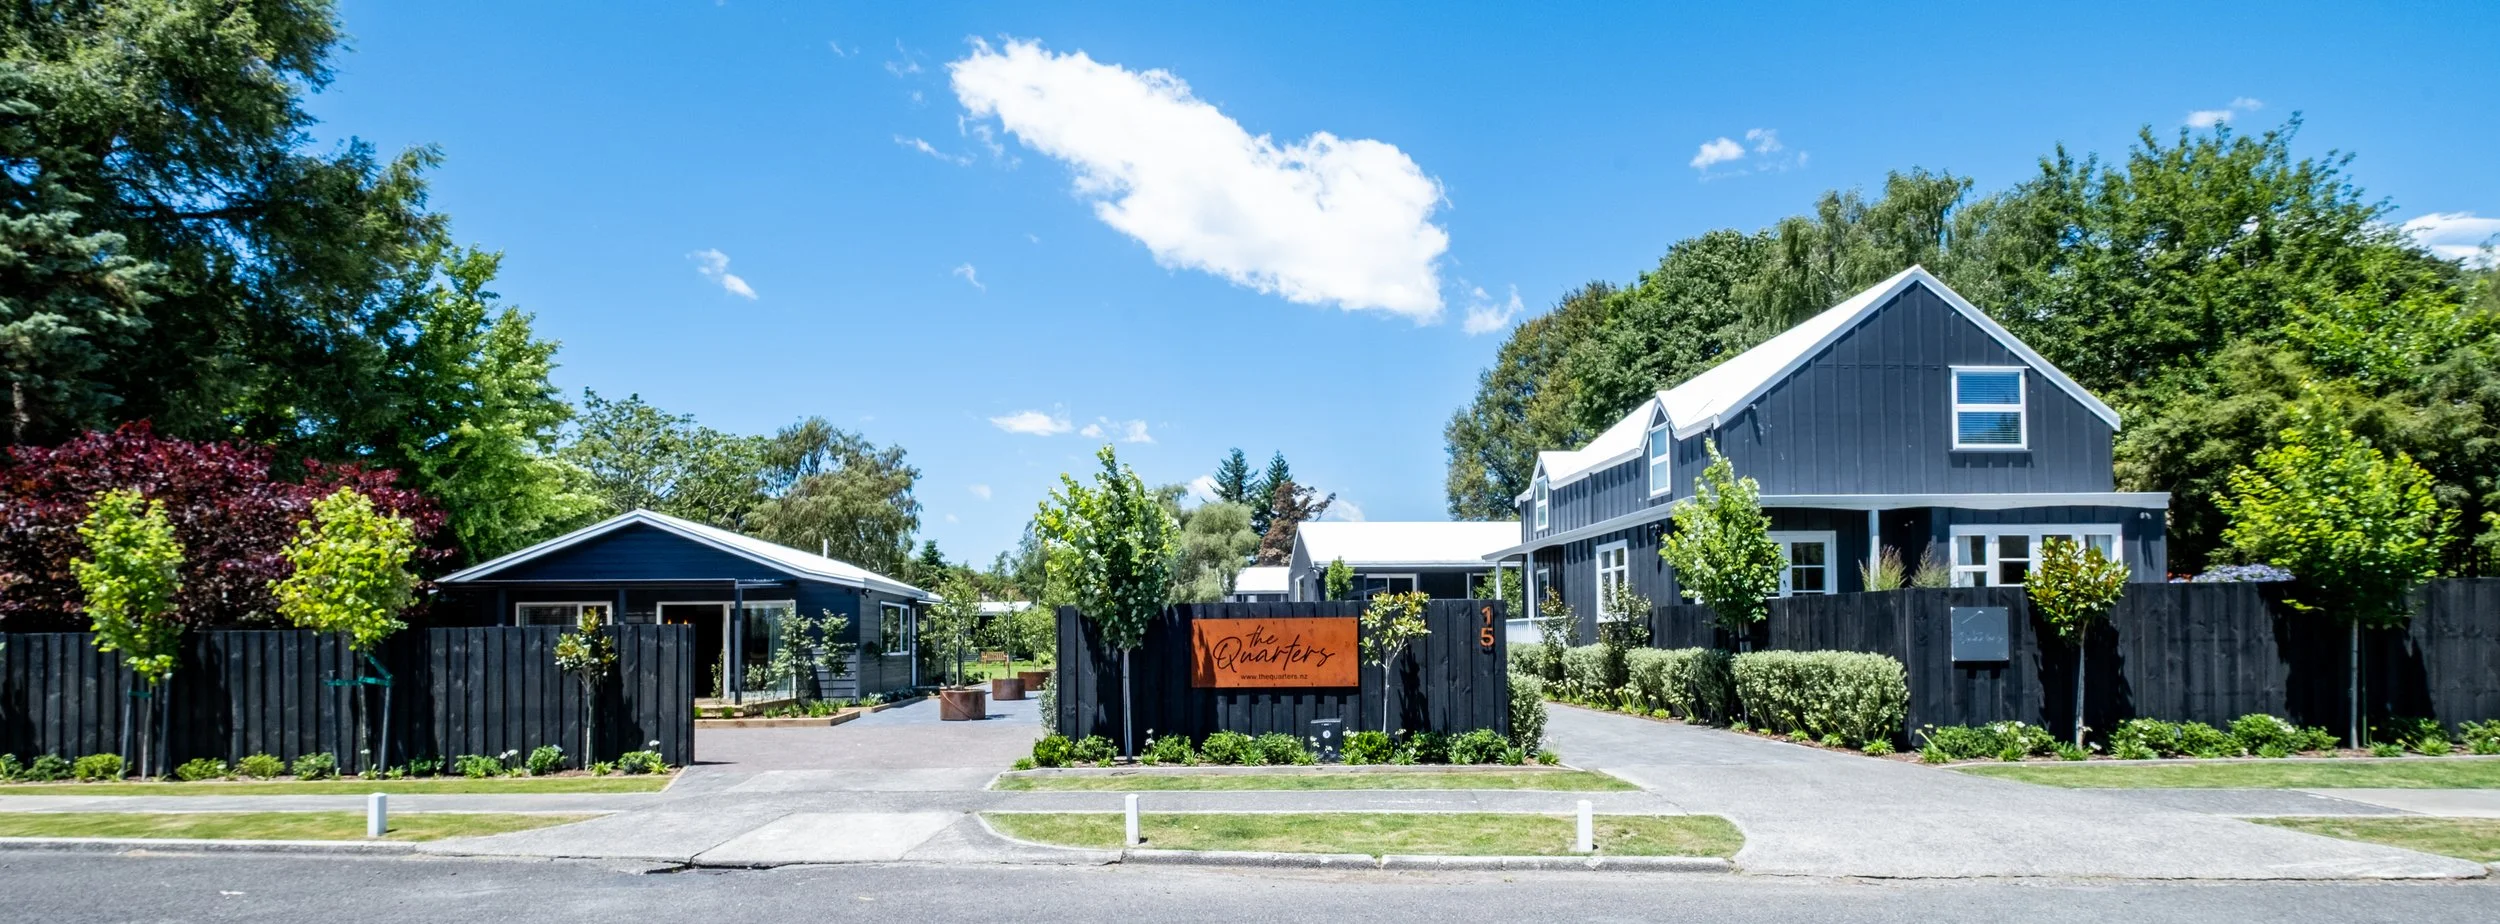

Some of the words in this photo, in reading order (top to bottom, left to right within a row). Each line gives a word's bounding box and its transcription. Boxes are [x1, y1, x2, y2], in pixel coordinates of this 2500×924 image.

[1246, 624, 1279, 648] the
[1480, 606, 1494, 647] 15
[1213, 634, 1335, 673] Quarters
